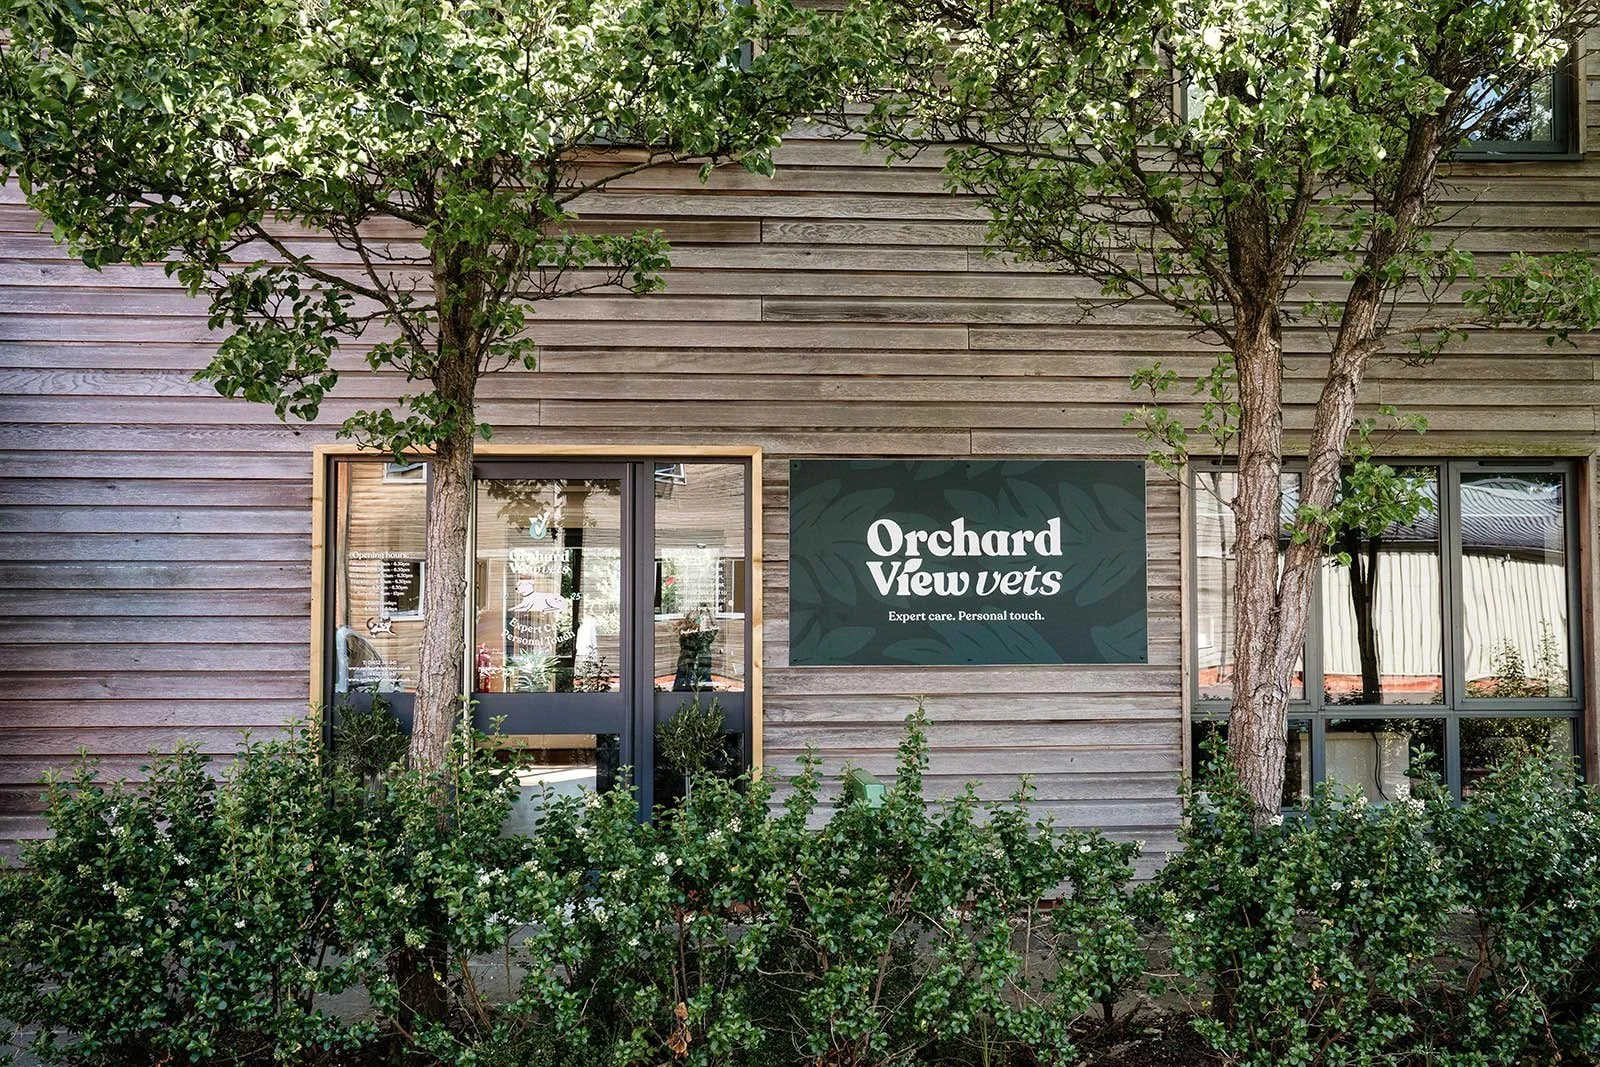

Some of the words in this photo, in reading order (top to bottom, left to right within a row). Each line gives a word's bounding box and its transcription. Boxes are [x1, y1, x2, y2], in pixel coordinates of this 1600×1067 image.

[867, 517, 1063, 557] Orchard
[352, 551, 384, 560] Opening
[866, 558, 970, 596] View
[976, 565, 1064, 596] vets
[509, 617, 542, 633] Expert
[888, 611, 927, 623] Expert
[928, 613, 956, 621] care.
[958, 610, 1007, 621] Personal
[1009, 610, 1045, 621] touch.
[501, 628, 544, 646] Personal
